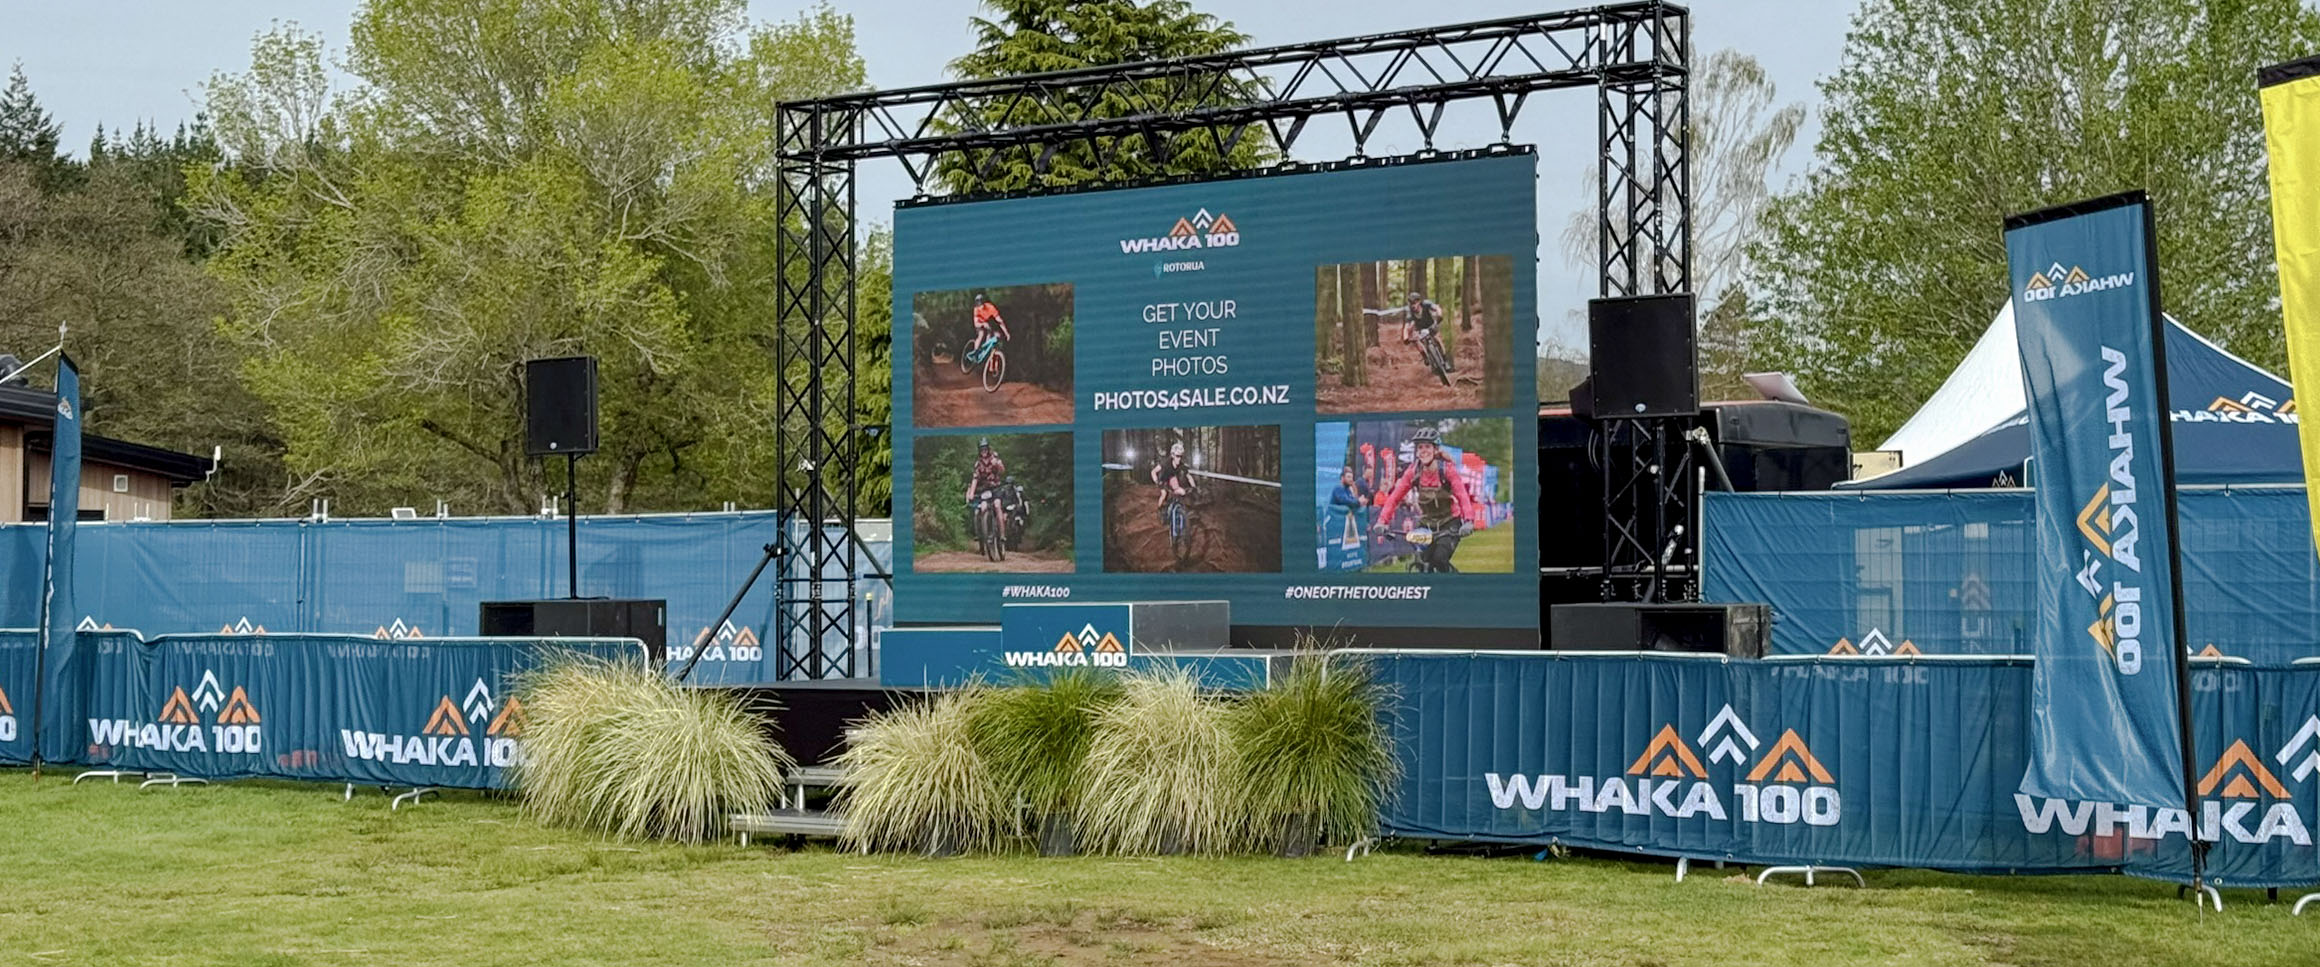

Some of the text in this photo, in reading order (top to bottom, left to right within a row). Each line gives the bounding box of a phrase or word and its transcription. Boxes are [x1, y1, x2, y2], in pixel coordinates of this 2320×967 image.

[1120, 232, 1240, 253] WHAKA 100
[1163, 261, 1204, 272] ROTORUA
[1143, 300, 1236, 323] GET YOUR
[1159, 329, 1220, 349] EVENT
[1152, 356, 1228, 376] PHOTOS
[1094, 385, 1290, 411] PHOTOS4SALE.CO.NZ
[2169, 410, 2275, 424] HAKA
[1002, 586, 1070, 598] #WHAKA100
[1285, 586, 1431, 600] #ONEOFTHETOUGHEST
[666, 646, 763, 661] HAKA 100
[1005, 651, 1128, 667] WHAKA 100
[88, 718, 262, 754] WHAKA 100
[341, 729, 478, 767] WHAKA
[1484, 773, 1842, 826] WHAKA 100
[2013, 793, 2313, 845] WHAKA
